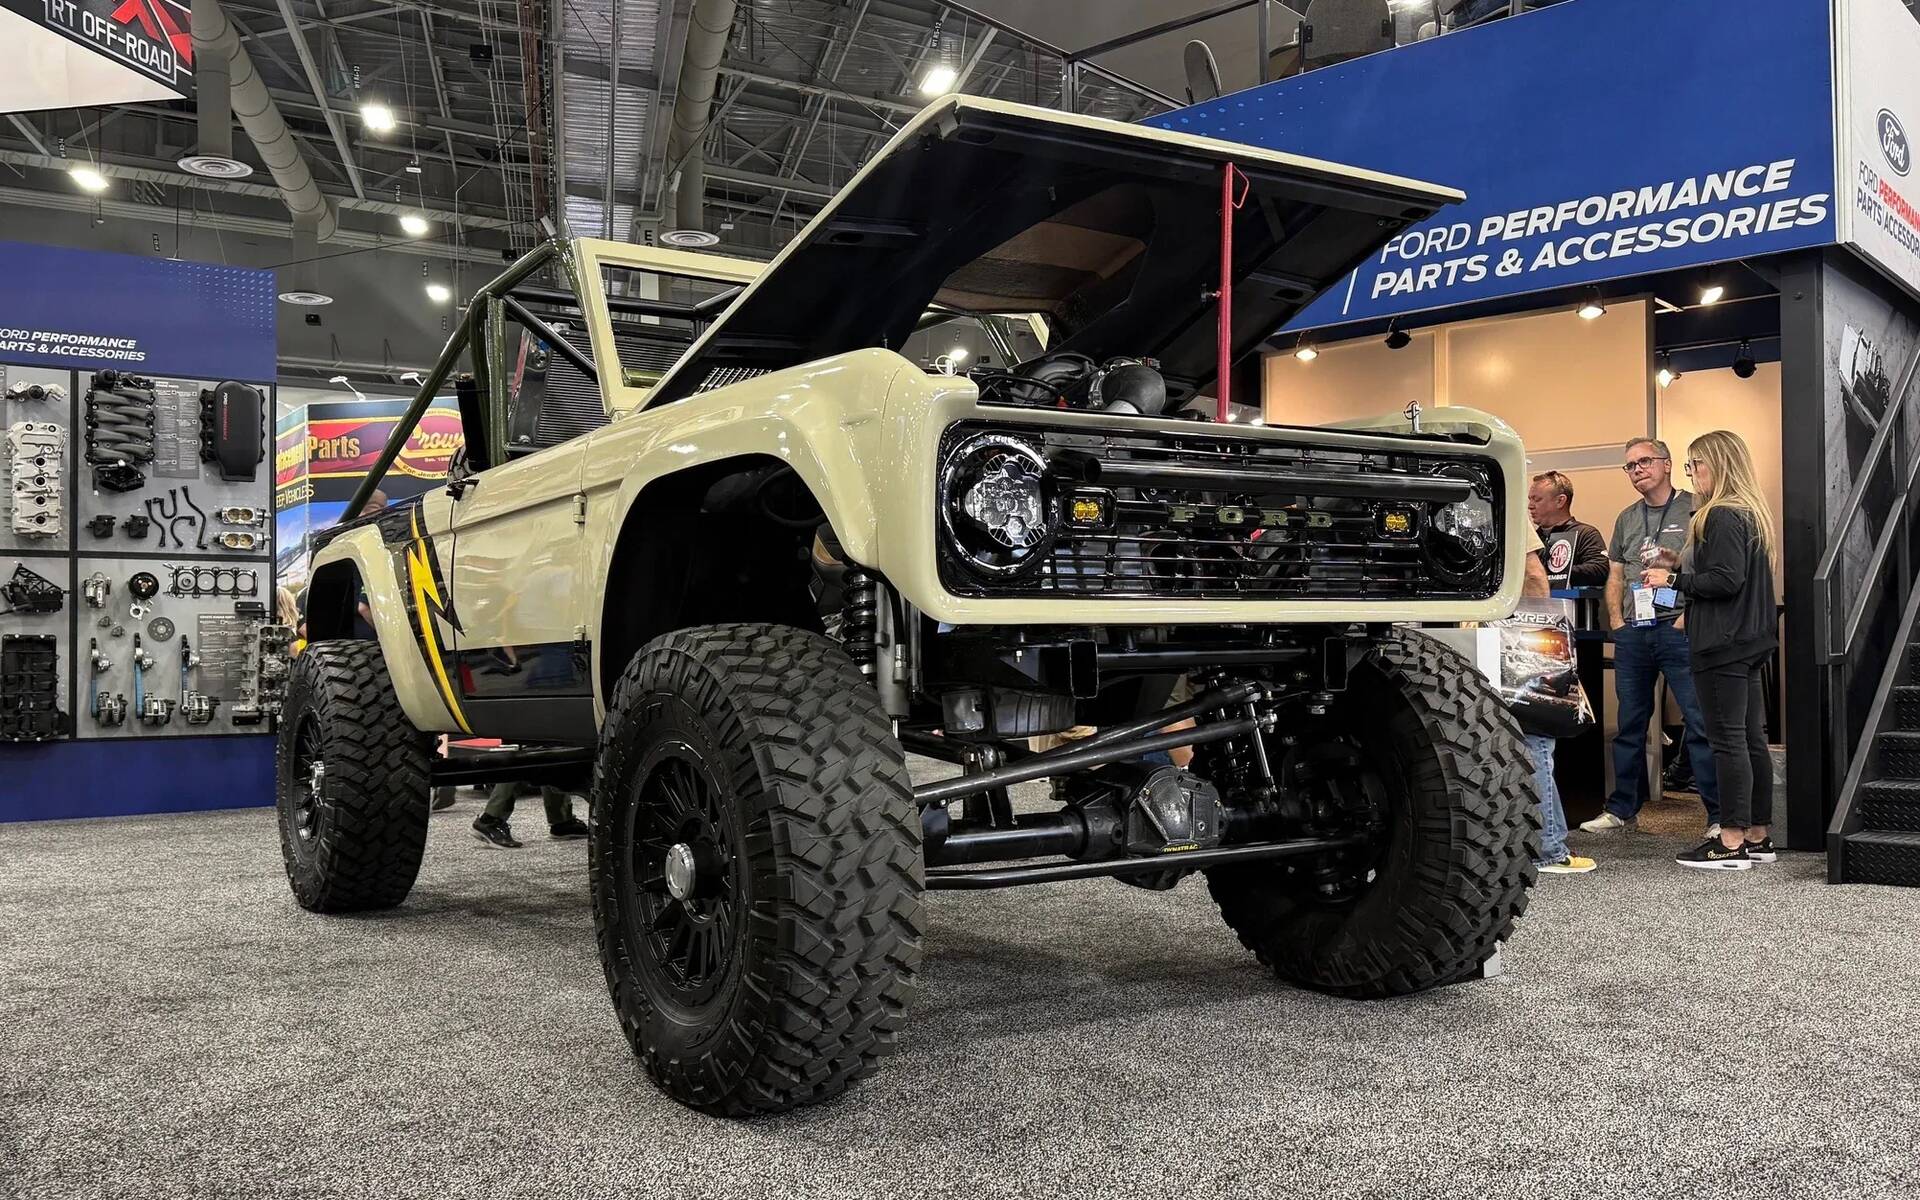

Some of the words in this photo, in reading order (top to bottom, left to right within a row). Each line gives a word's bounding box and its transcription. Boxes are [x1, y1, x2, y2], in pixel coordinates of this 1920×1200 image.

[82, 10, 171, 75] OFF-ROAD
[1883, 118, 1905, 168] Ford
[1859, 160, 1878, 194] FORD
[1380, 222, 1471, 264] FORD
[1476, 158, 1796, 246] PERFORMANCE
[1856, 187, 1882, 226] PARTS
[1371, 254, 1490, 300] PARTS
[1494, 247, 1525, 278] &
[1529, 193, 1830, 272] ACCESSORIES
[31, 331, 137, 350] PERFORMANCE
[37, 343, 49, 354] &
[50, 345, 146, 362] ACCESSORIES
[306, 435, 361, 462] Parts
[1171, 504, 1333, 528] FORD
